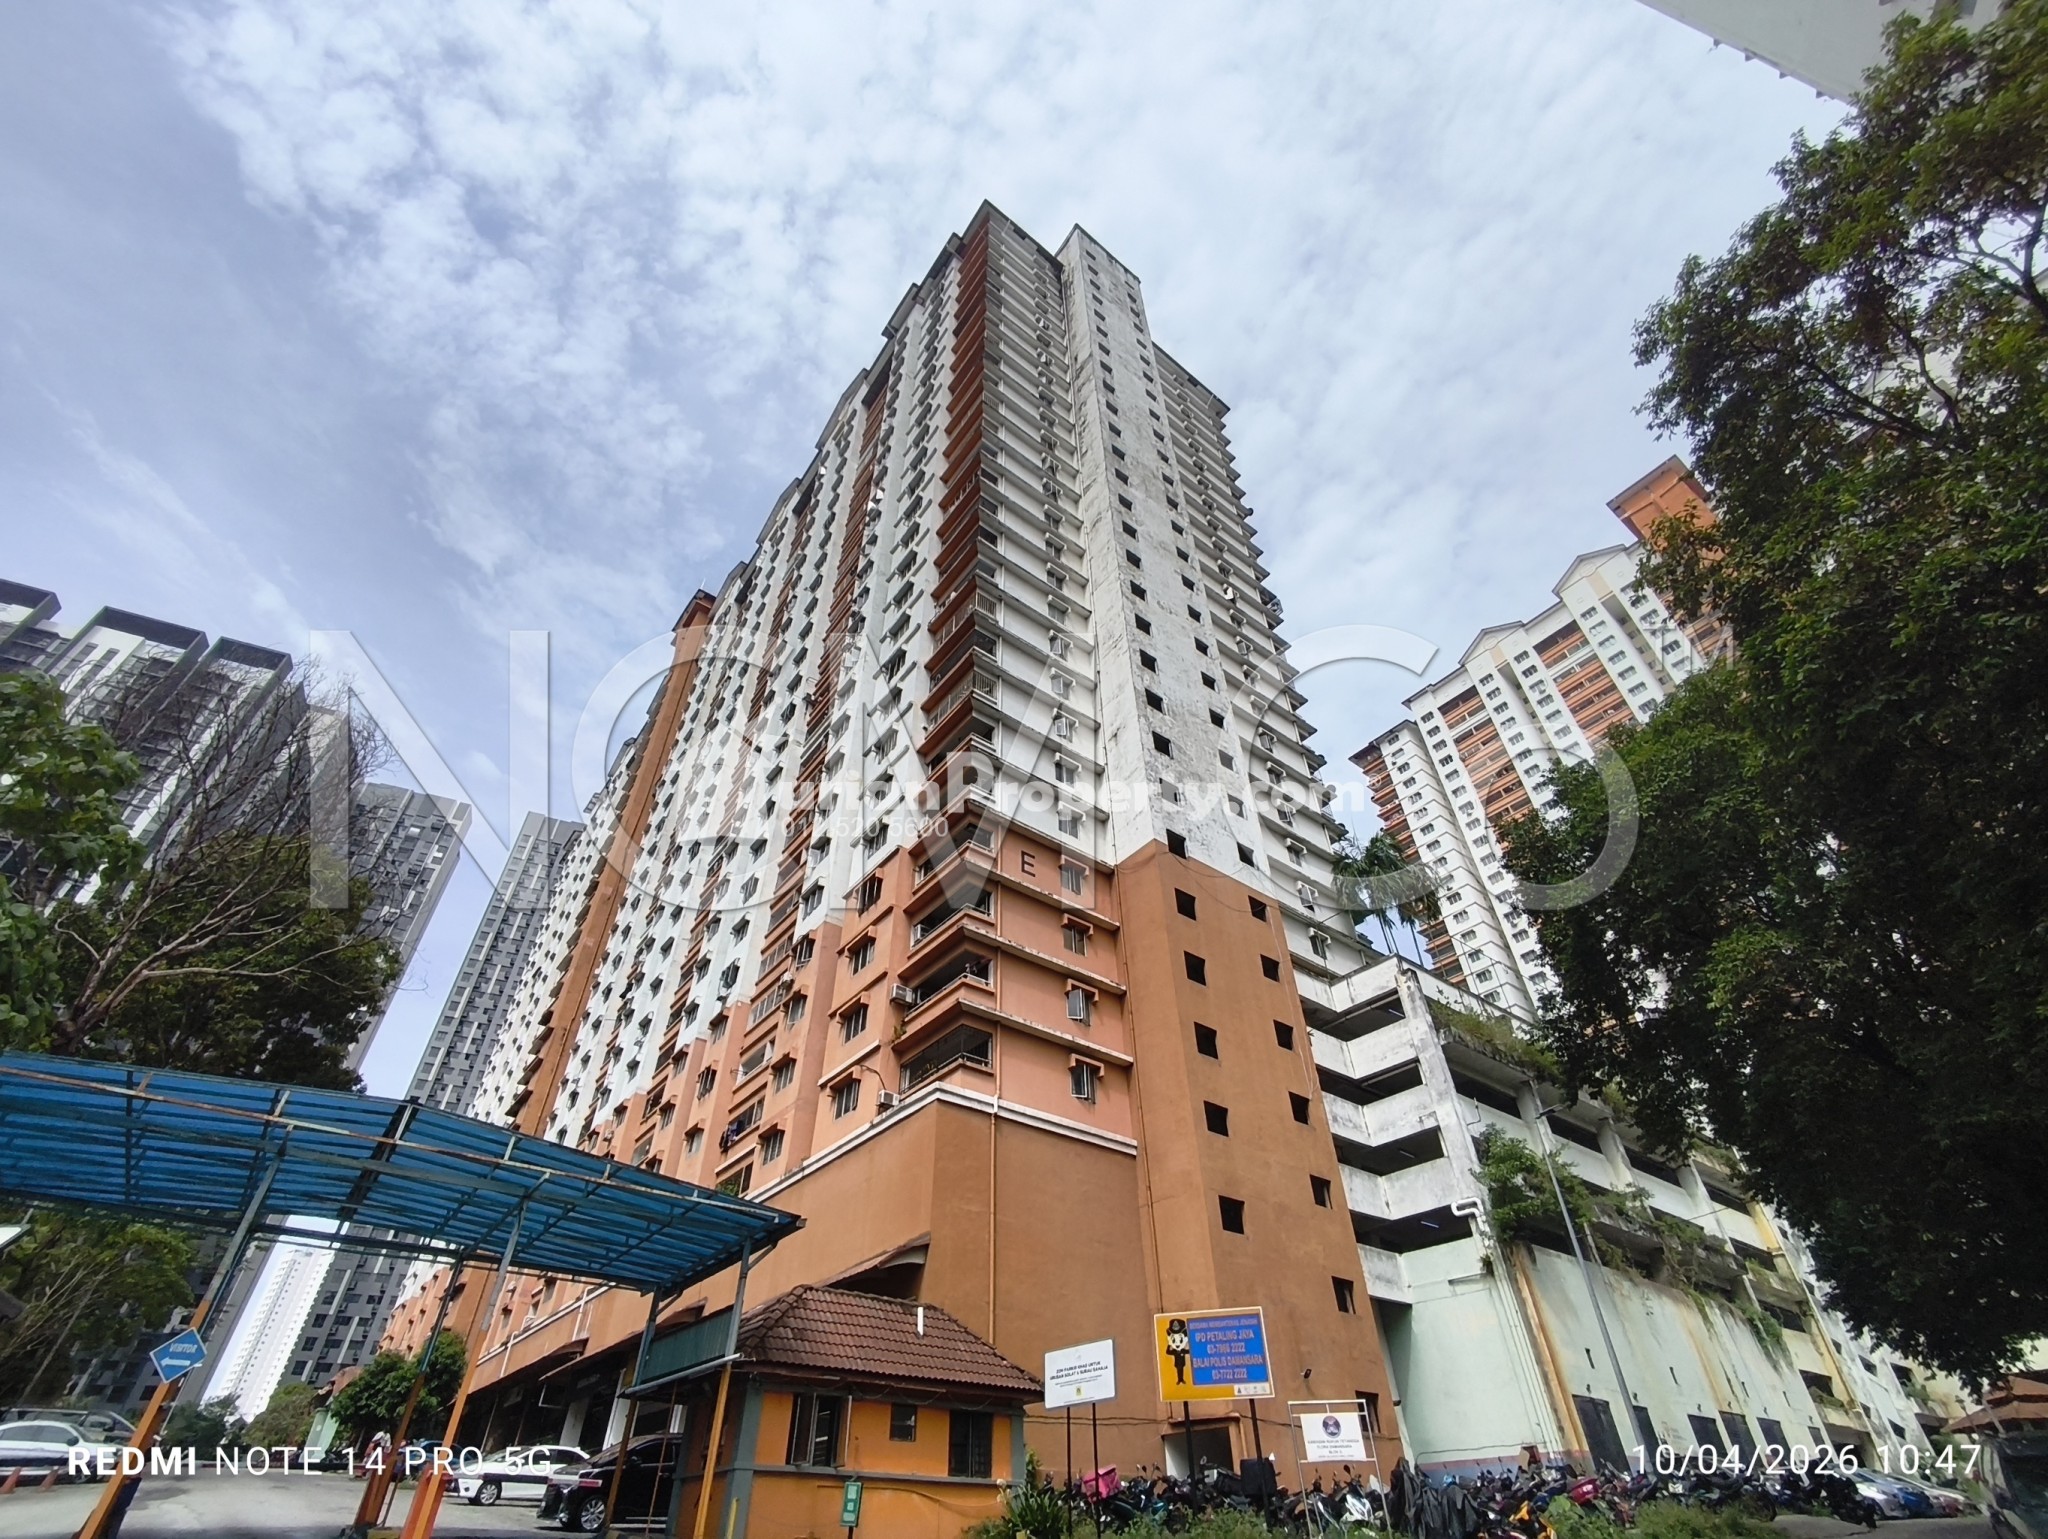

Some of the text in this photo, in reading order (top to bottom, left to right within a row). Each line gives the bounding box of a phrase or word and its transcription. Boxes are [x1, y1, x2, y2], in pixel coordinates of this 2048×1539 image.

[1021, 850, 1036, 878] E
[1207, 1330, 1237, 1341] PETALING
[1238, 1329, 1254, 1339] JAYA
[1210, 1356, 1226, 1367] POLIS
